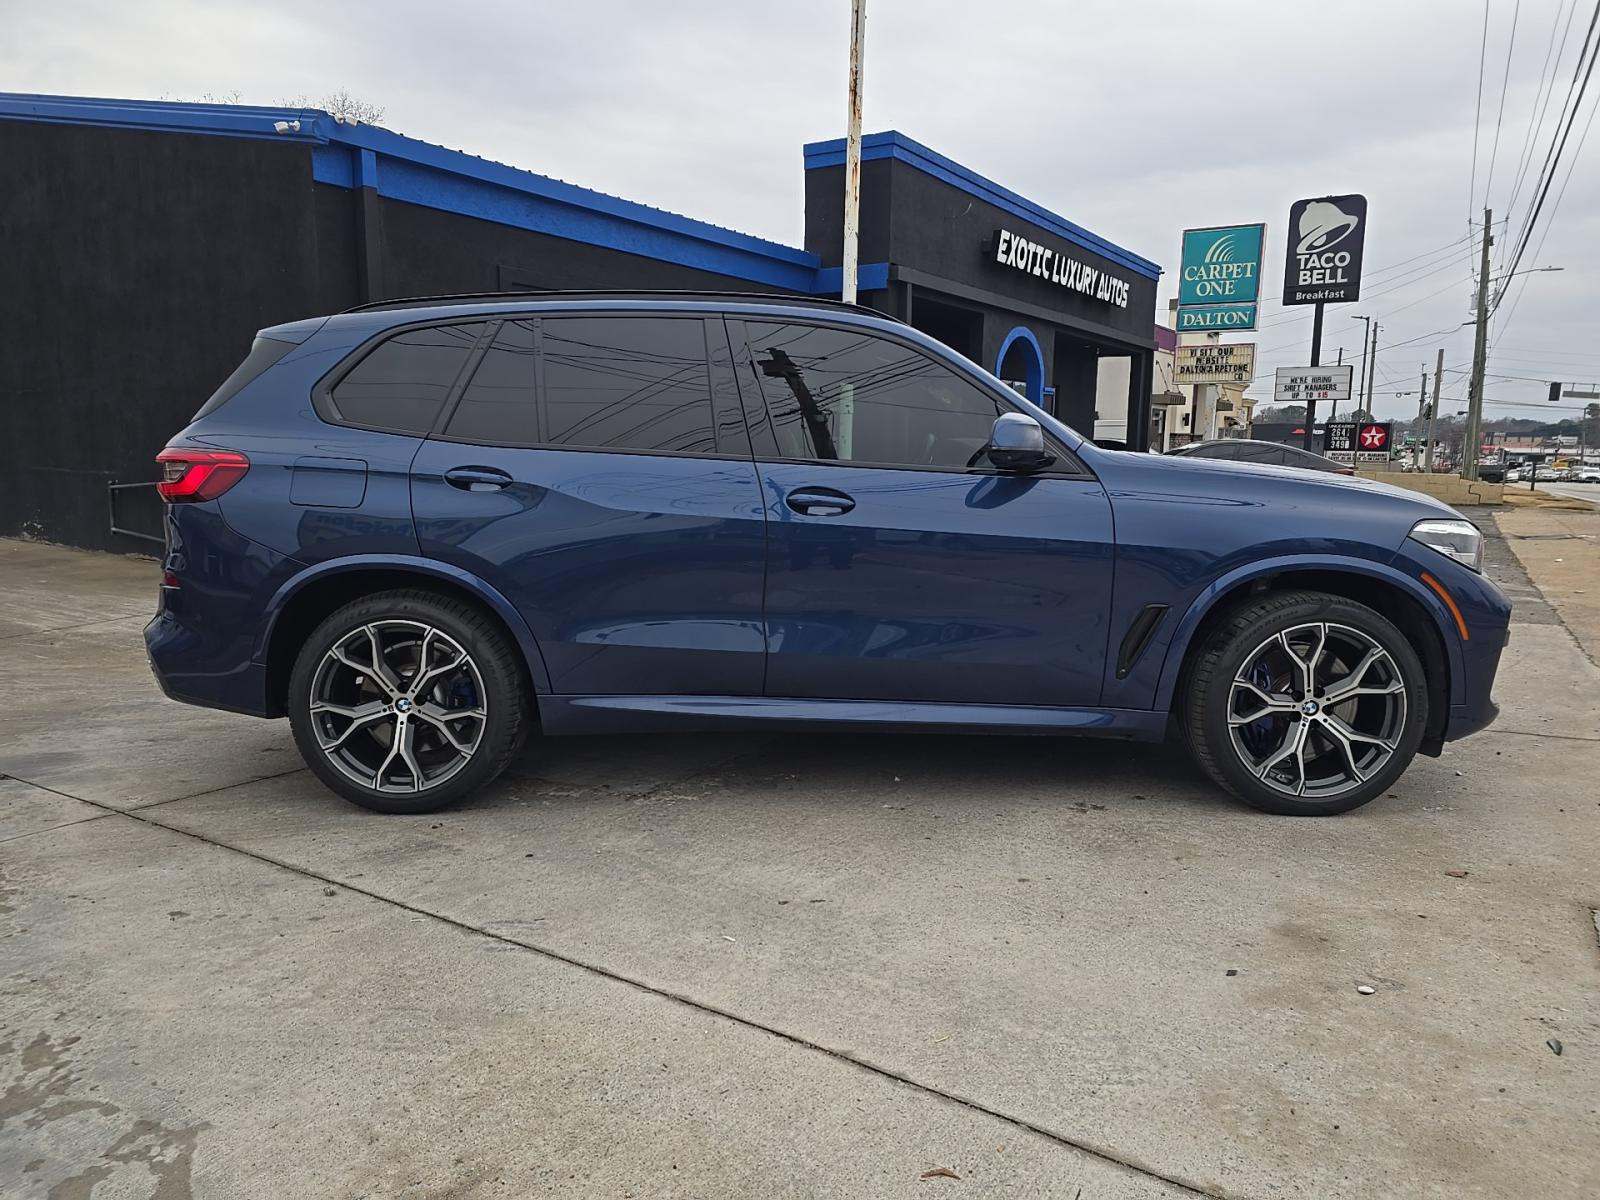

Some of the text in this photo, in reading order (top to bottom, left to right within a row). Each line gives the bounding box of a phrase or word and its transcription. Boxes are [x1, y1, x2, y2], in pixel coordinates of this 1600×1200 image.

[997, 229, 1130, 308] EXOTIC LUXURY AUTOS
[1297, 251, 1351, 270] TACO
[1184, 262, 1256, 281] CARPET
[1298, 268, 1348, 286] BELL
[1195, 279, 1236, 297] ONE
[1295, 289, 1345, 301] Breakfast
[1183, 310, 1251, 327] DALTON
[1190, 347, 1234, 357] VISIT OUR
[1283, 384, 1338, 392] SHIFT MANAGERS
[1290, 376, 1332, 384] WE'RE HIRING
